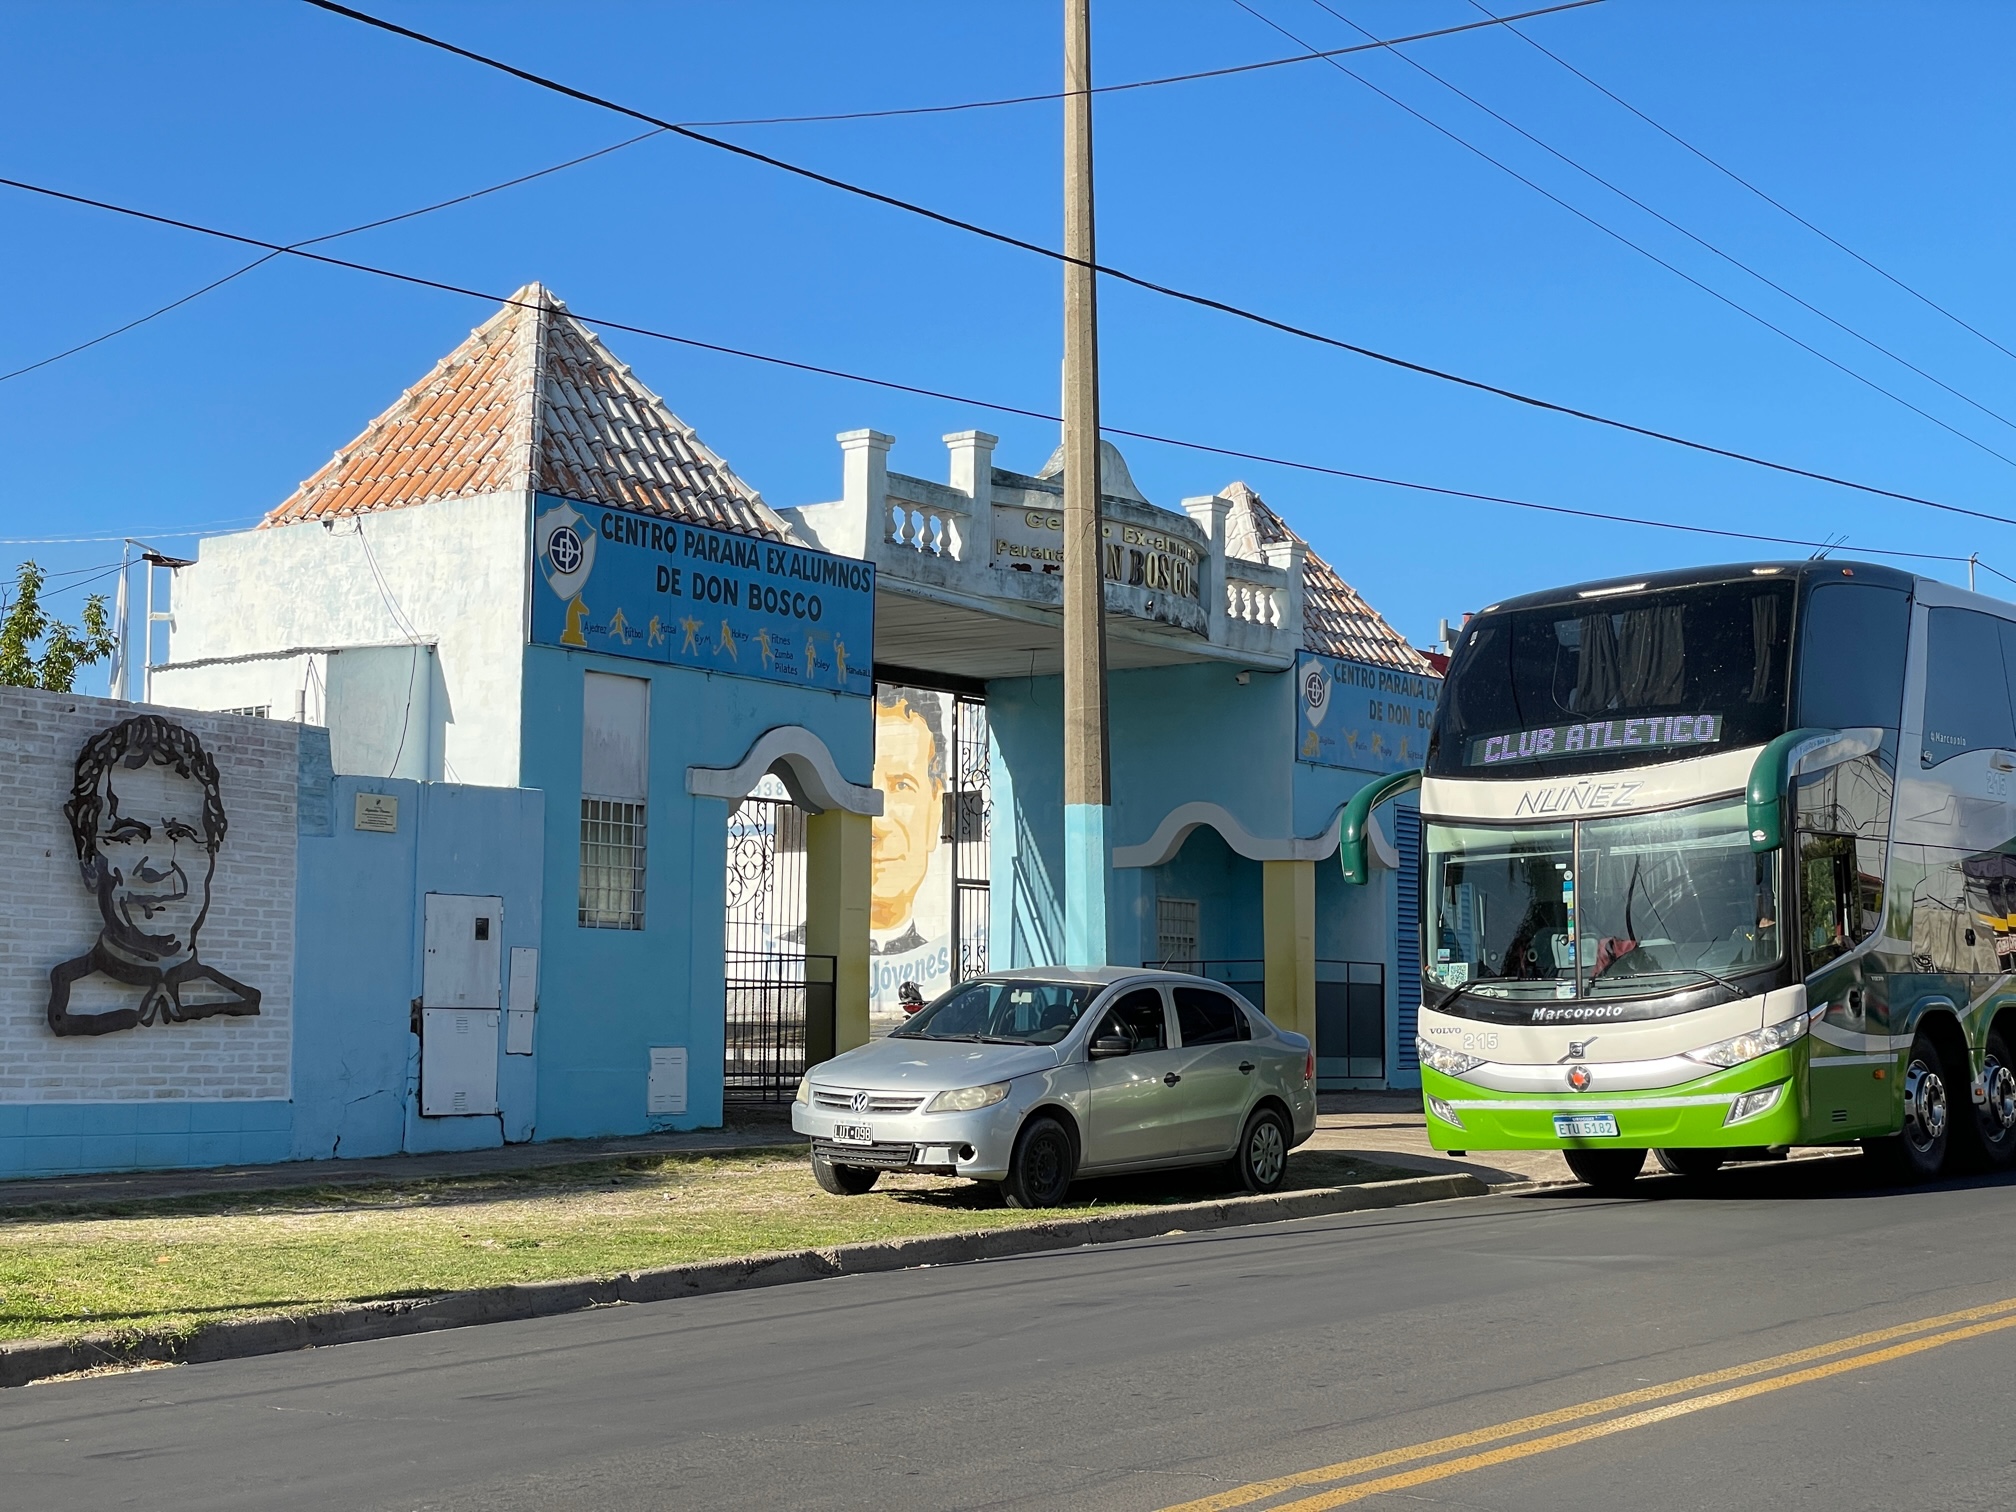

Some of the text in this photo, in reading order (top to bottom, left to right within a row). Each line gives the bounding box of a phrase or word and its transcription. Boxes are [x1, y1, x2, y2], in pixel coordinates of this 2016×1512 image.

[601, 512, 677, 553] CENTRO
[684, 530, 761, 571] PARANÁ
[767, 548, 787, 577] EX
[789, 553, 871, 593] ALUMNOS
[1128, 549, 1190, 598] BOSCO
[656, 565, 822, 621] DE DON BOSCO
[584, 621, 607, 634] Ajedrez
[774, 648, 793, 660] Zumba
[774, 662, 798, 675] Pilates
[1333, 663, 1375, 689] CENTRO
[1427, 682, 1439, 701] EX
[1369, 699, 1382, 721] DE
[1387, 703, 1411, 726] DON
[1485, 714, 1715, 763] CLUB ATLETICO
[1515, 778, 1645, 816] NUÑEZ
[1986, 770, 2008, 797] 215
[870, 946, 950, 998] Jóvenes
[1532, 1006, 1623, 1020] Marcopolo
[1463, 1033, 1499, 1049] 215
[1559, 1123, 1613, 1135] ETU 5182
